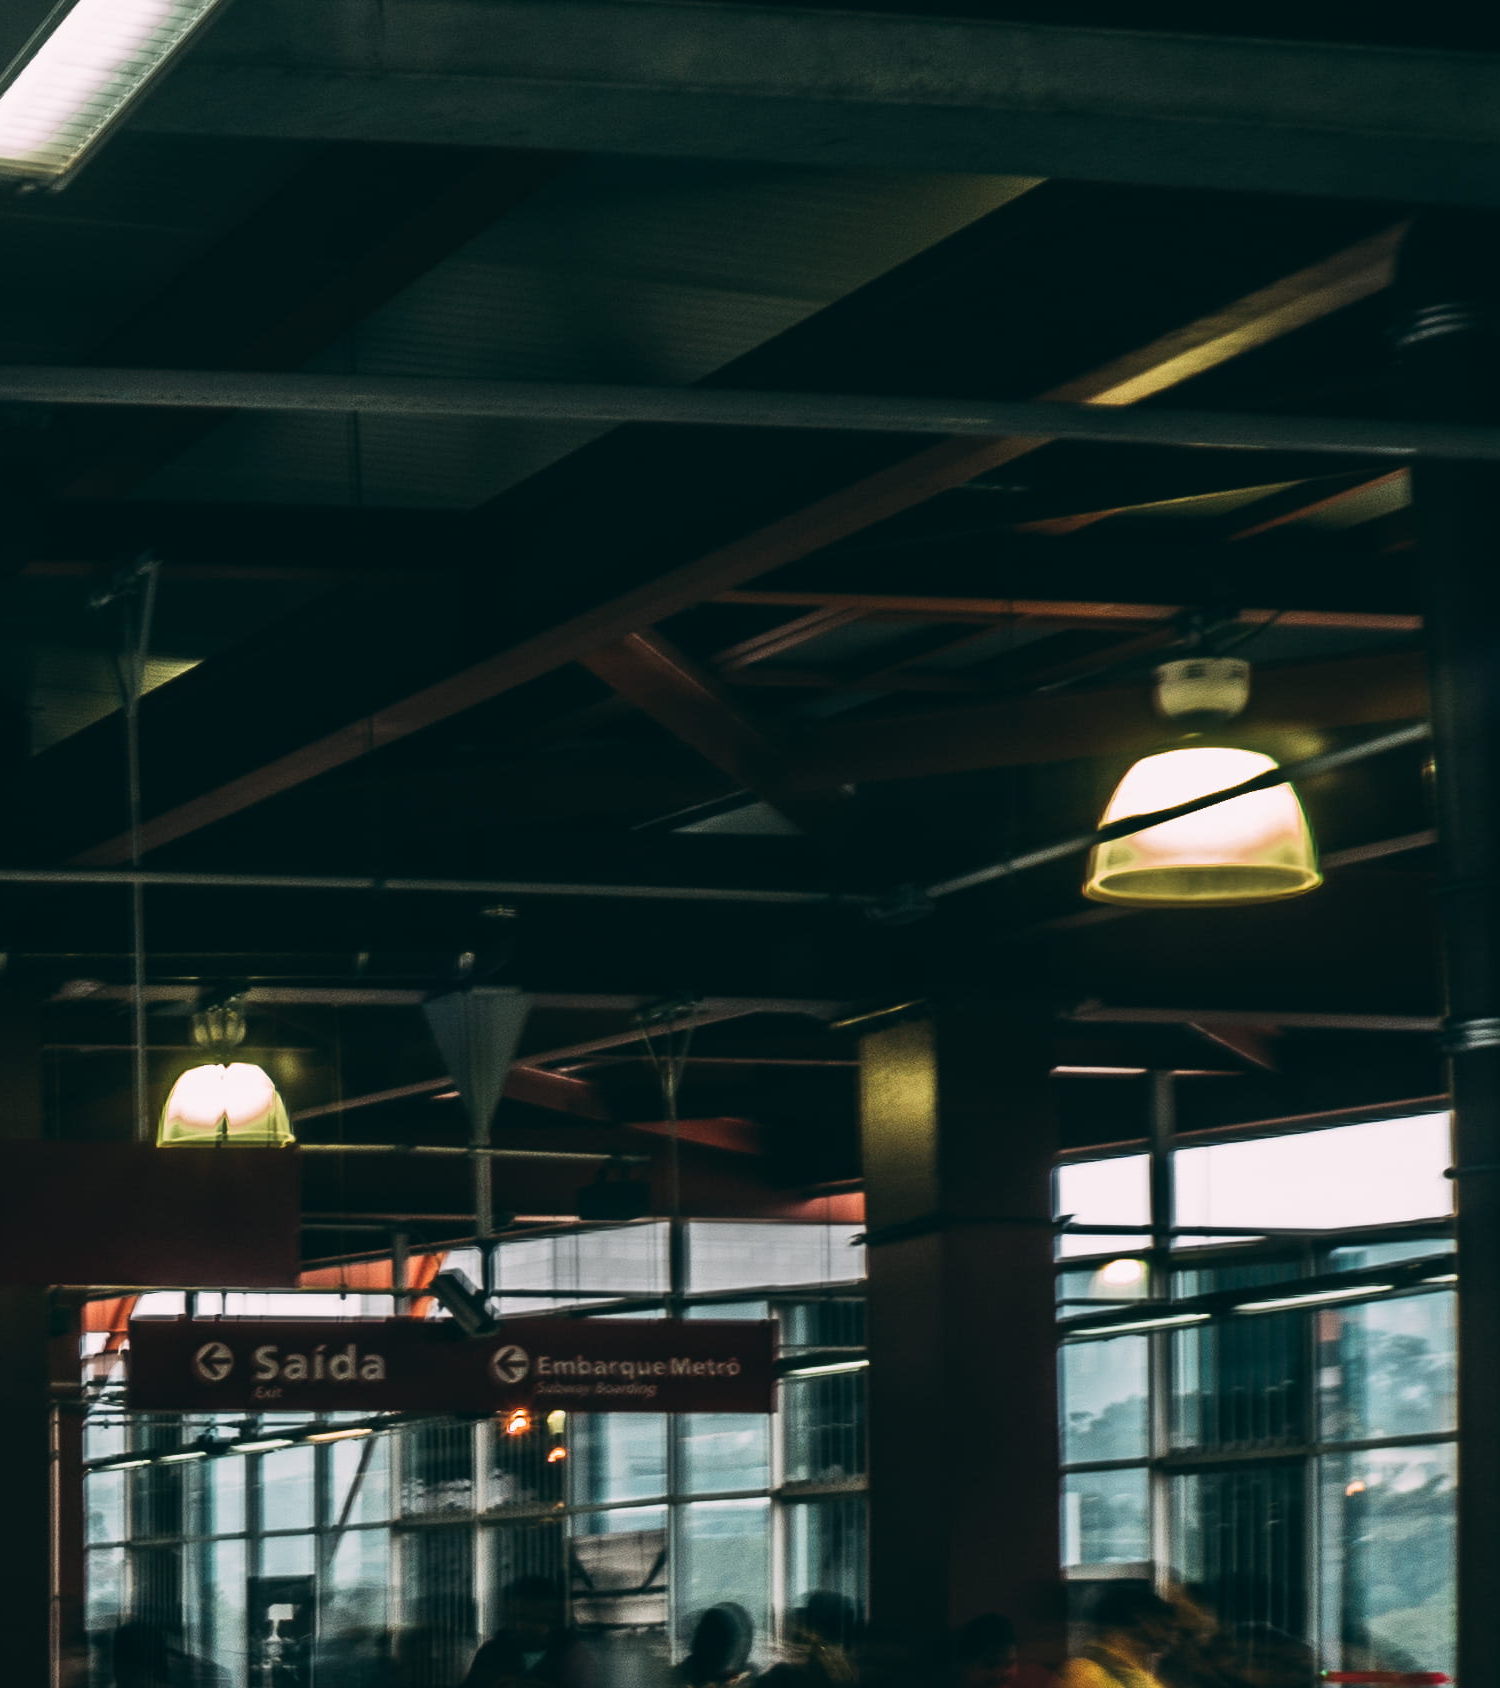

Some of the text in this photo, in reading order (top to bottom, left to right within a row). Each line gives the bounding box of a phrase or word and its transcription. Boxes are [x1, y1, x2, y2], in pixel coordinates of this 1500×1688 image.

[253, 1342, 386, 1380] Saída
[537, 1354, 742, 1380] Embarque Metrô
[254, 1386, 283, 1399] Exit
[536, 1382, 659, 1399] Subway Boarding
